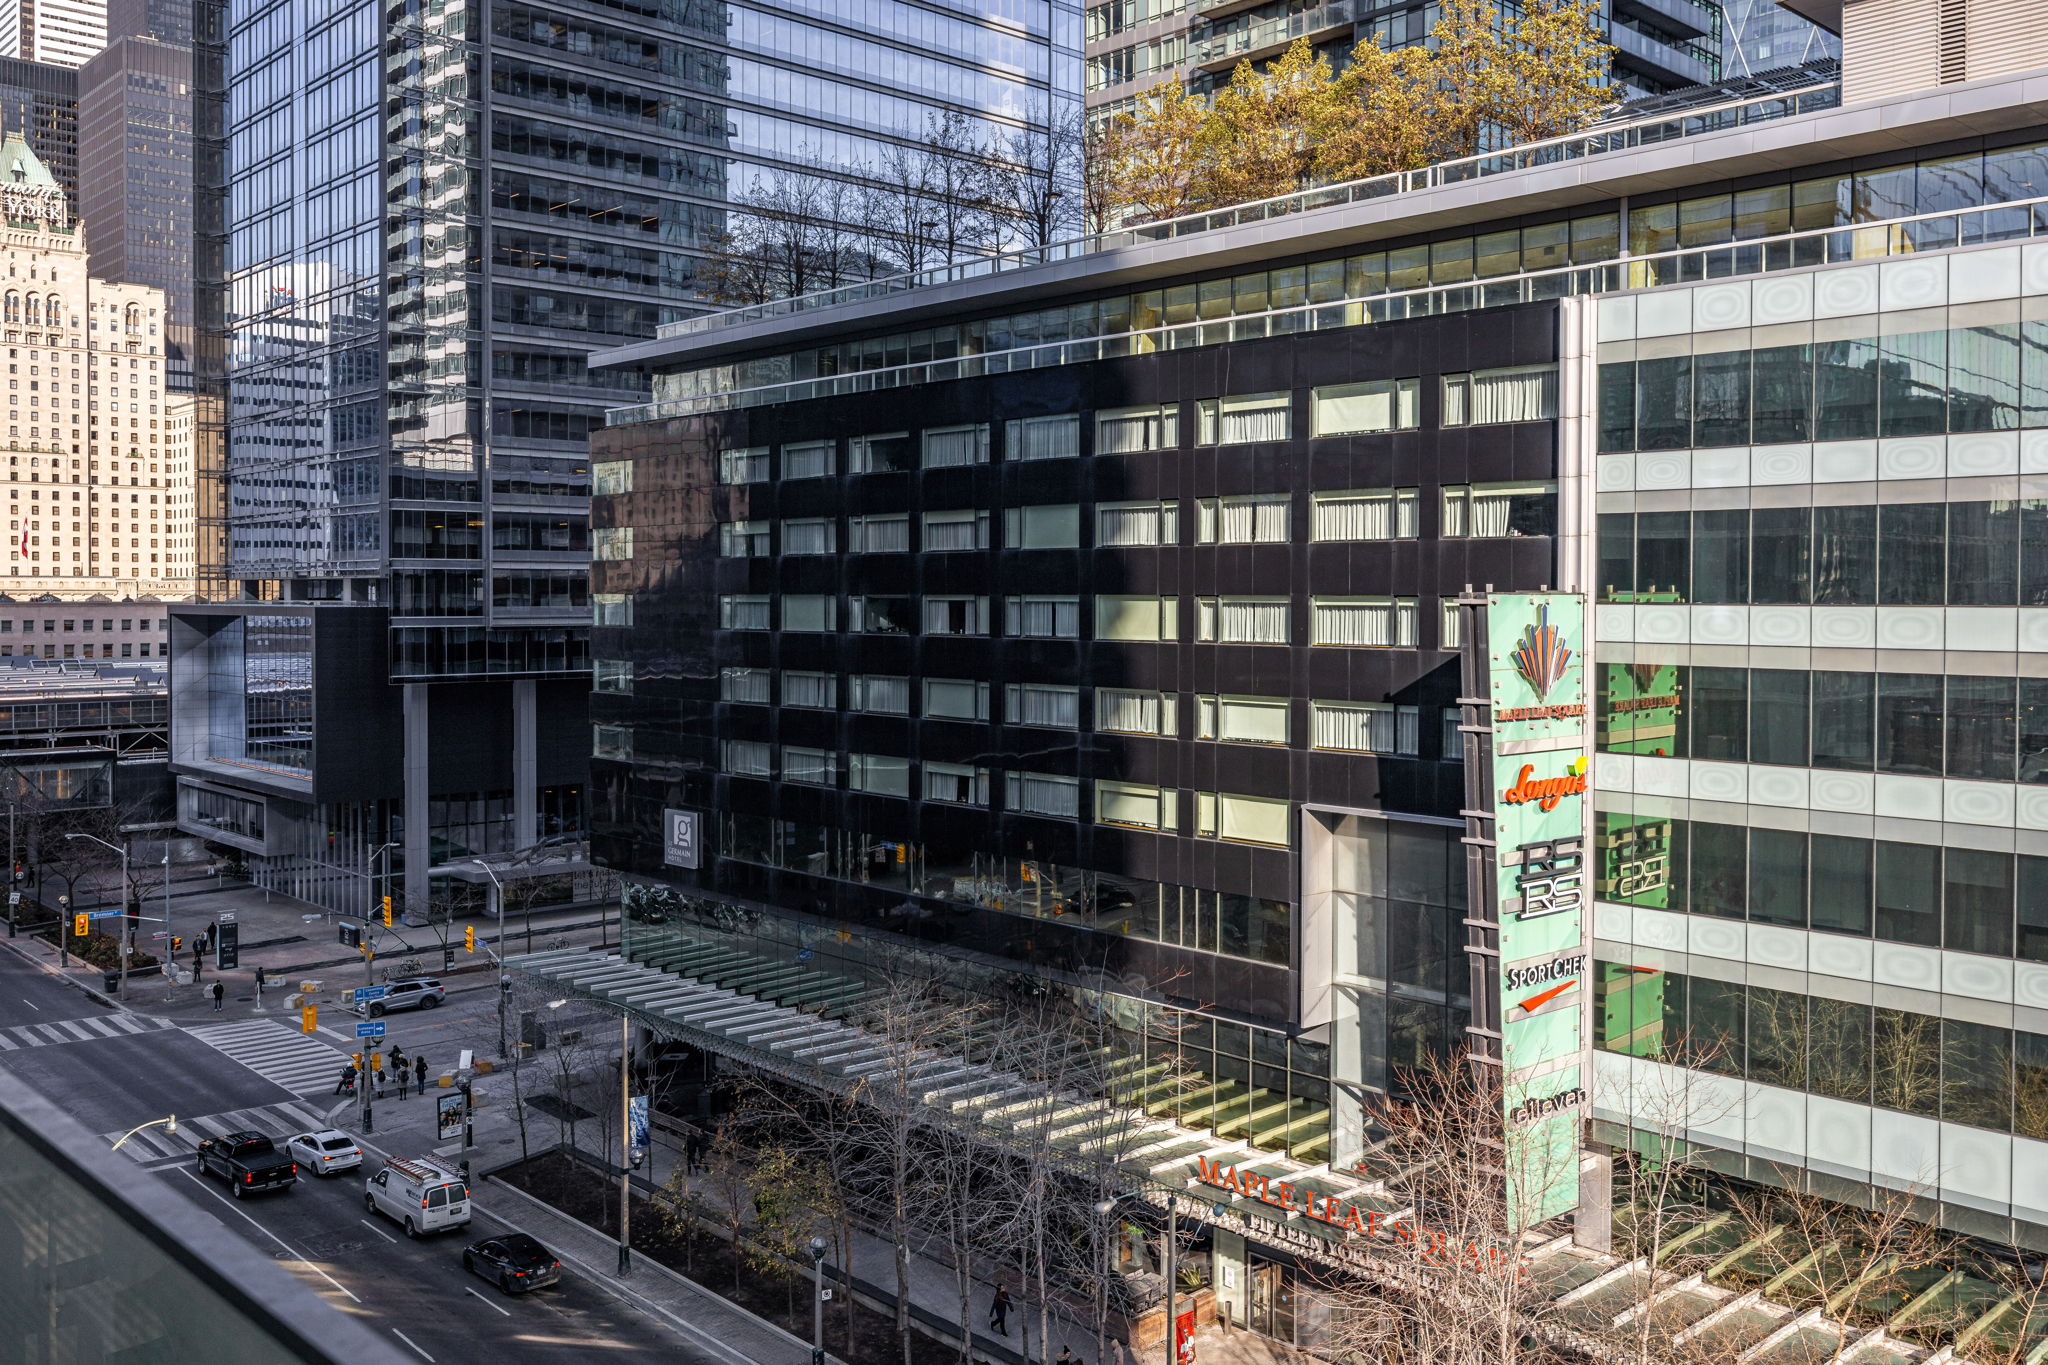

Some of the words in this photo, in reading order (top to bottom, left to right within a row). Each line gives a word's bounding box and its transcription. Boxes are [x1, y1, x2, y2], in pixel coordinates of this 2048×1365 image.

[8, 199, 63, 219] YORK
[1498, 707, 1530, 721] MAPLE
[1531, 705, 1554, 719] LEAF
[668, 848, 692, 858] GERMAIN
[1519, 836, 1584, 881] RS
[1519, 873, 1584, 919] RS
[220, 912, 235, 921] 25
[1196, 1154, 1297, 1212] MAPLE
[1304, 1189, 1387, 1237] LEAF
